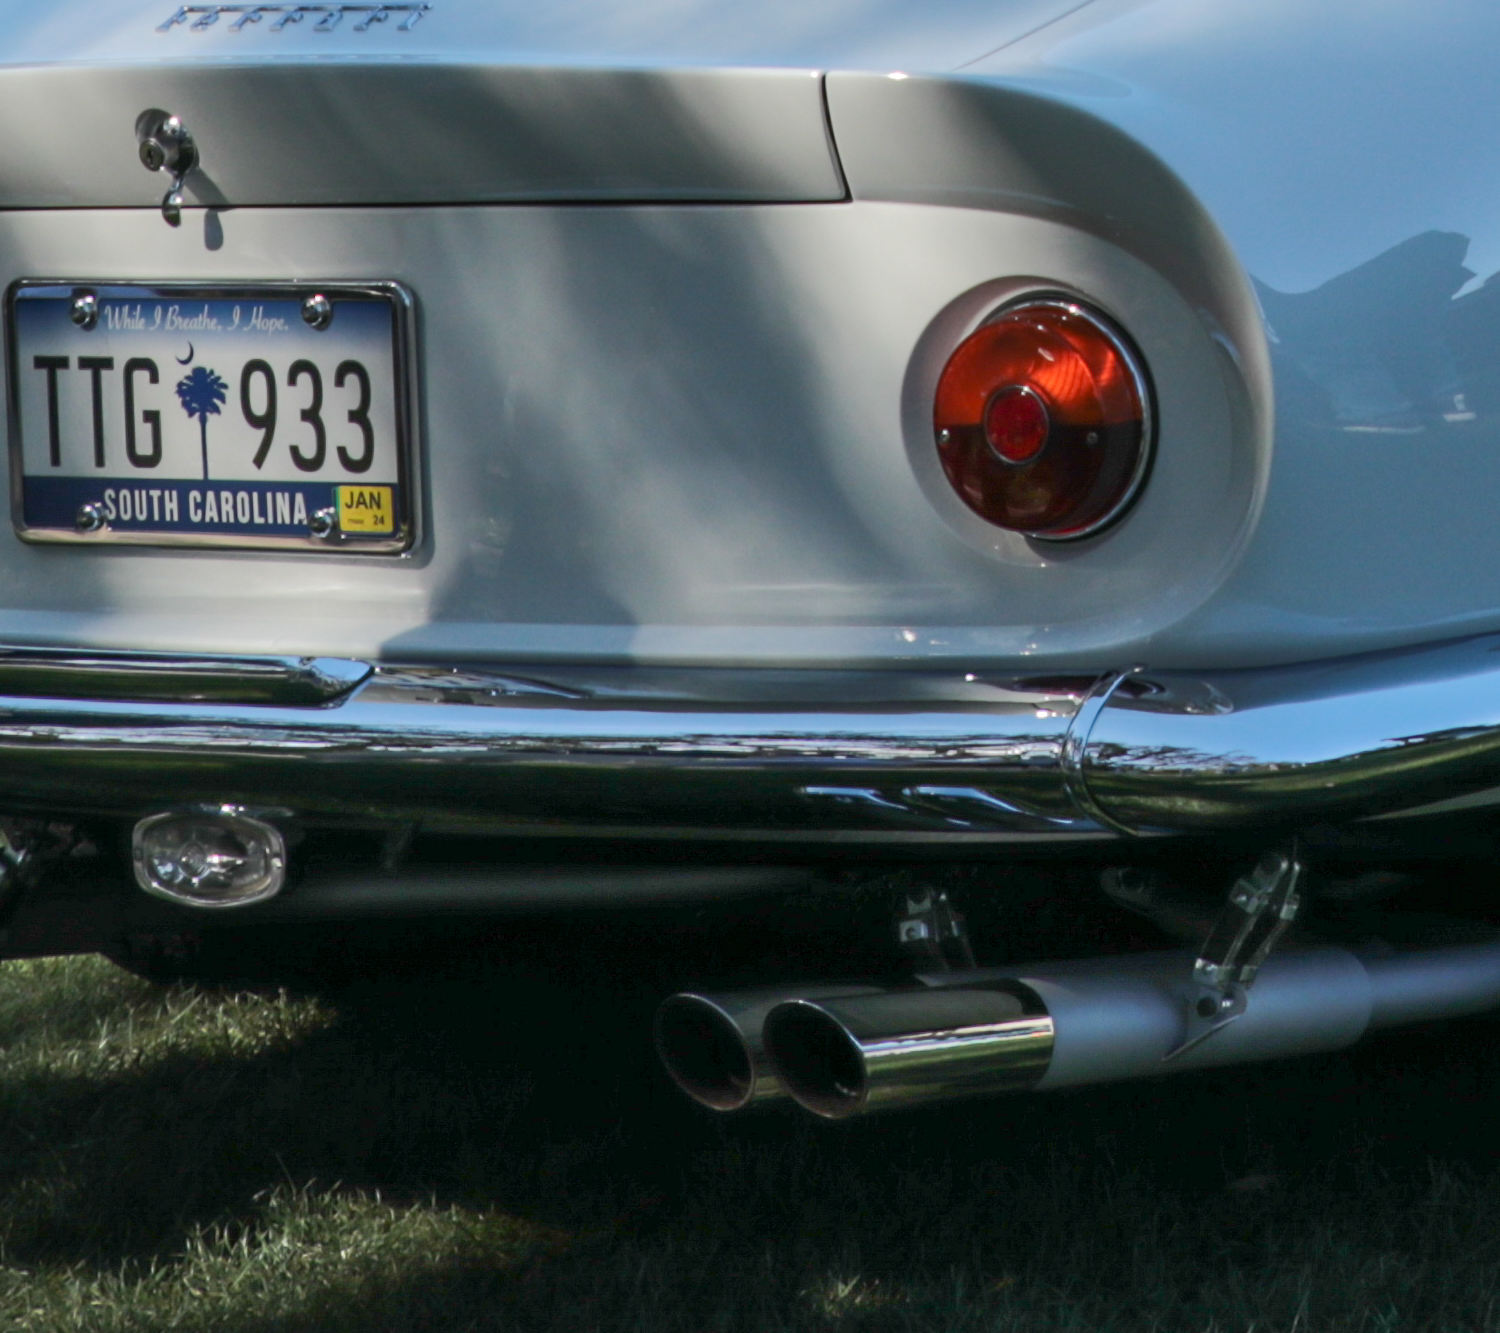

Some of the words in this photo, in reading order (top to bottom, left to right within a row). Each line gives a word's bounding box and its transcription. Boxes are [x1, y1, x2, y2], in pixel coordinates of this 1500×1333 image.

[155, 2, 433, 33] Ferrari
[103, 304, 146, 332] While
[148, 305, 164, 332] I
[227, 306, 241, 332] I
[242, 306, 290, 337] Hope.
[32, 354, 163, 469] TTG
[239, 357, 376, 475] 933
[103, 488, 179, 523] SOUTH
[188, 489, 308, 526] CAROLINA
[344, 490, 382, 510] JAN
[372, 514, 385, 526] 24
